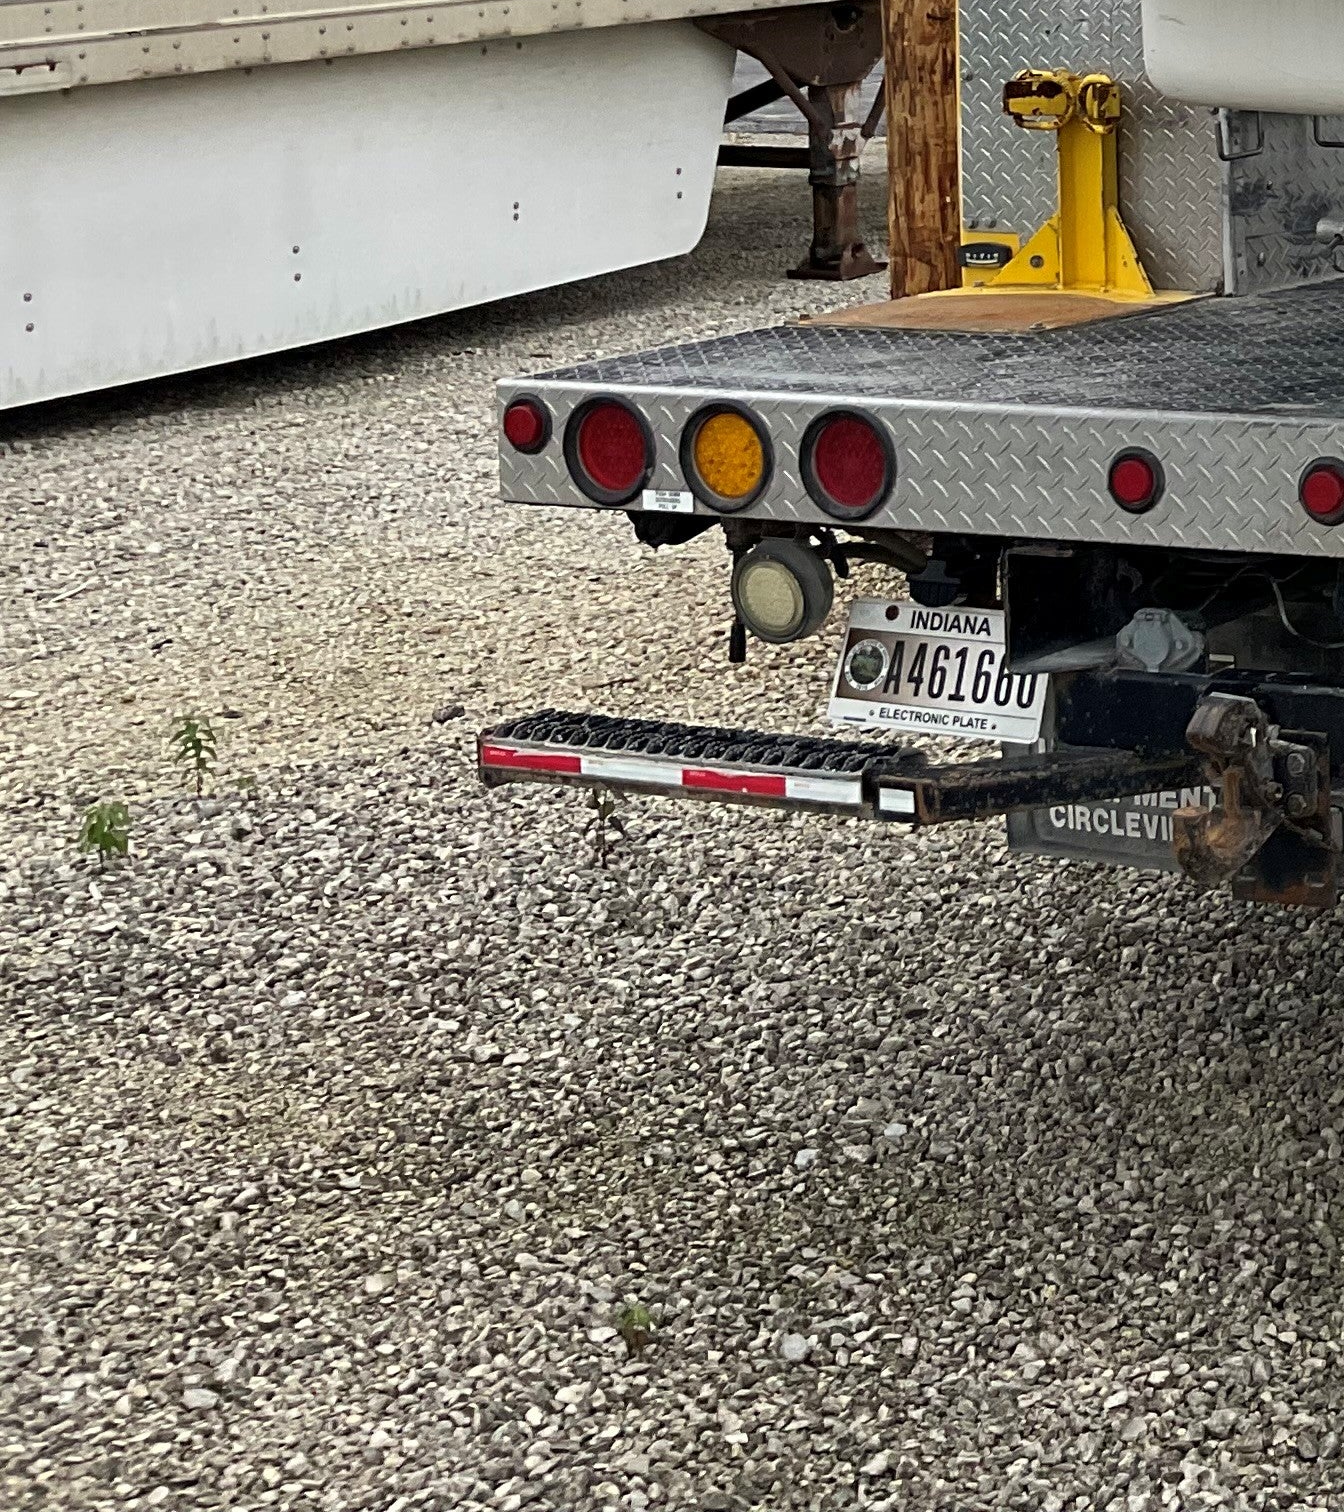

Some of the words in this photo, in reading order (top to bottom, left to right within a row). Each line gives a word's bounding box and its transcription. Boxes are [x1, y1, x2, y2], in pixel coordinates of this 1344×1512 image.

[910, 610, 991, 636] INDIANA
[879, 707, 950, 725] ELECTRONIC
[952, 715, 988, 730] PLATE
[1049, 804, 1174, 842] CIRCLEVI
